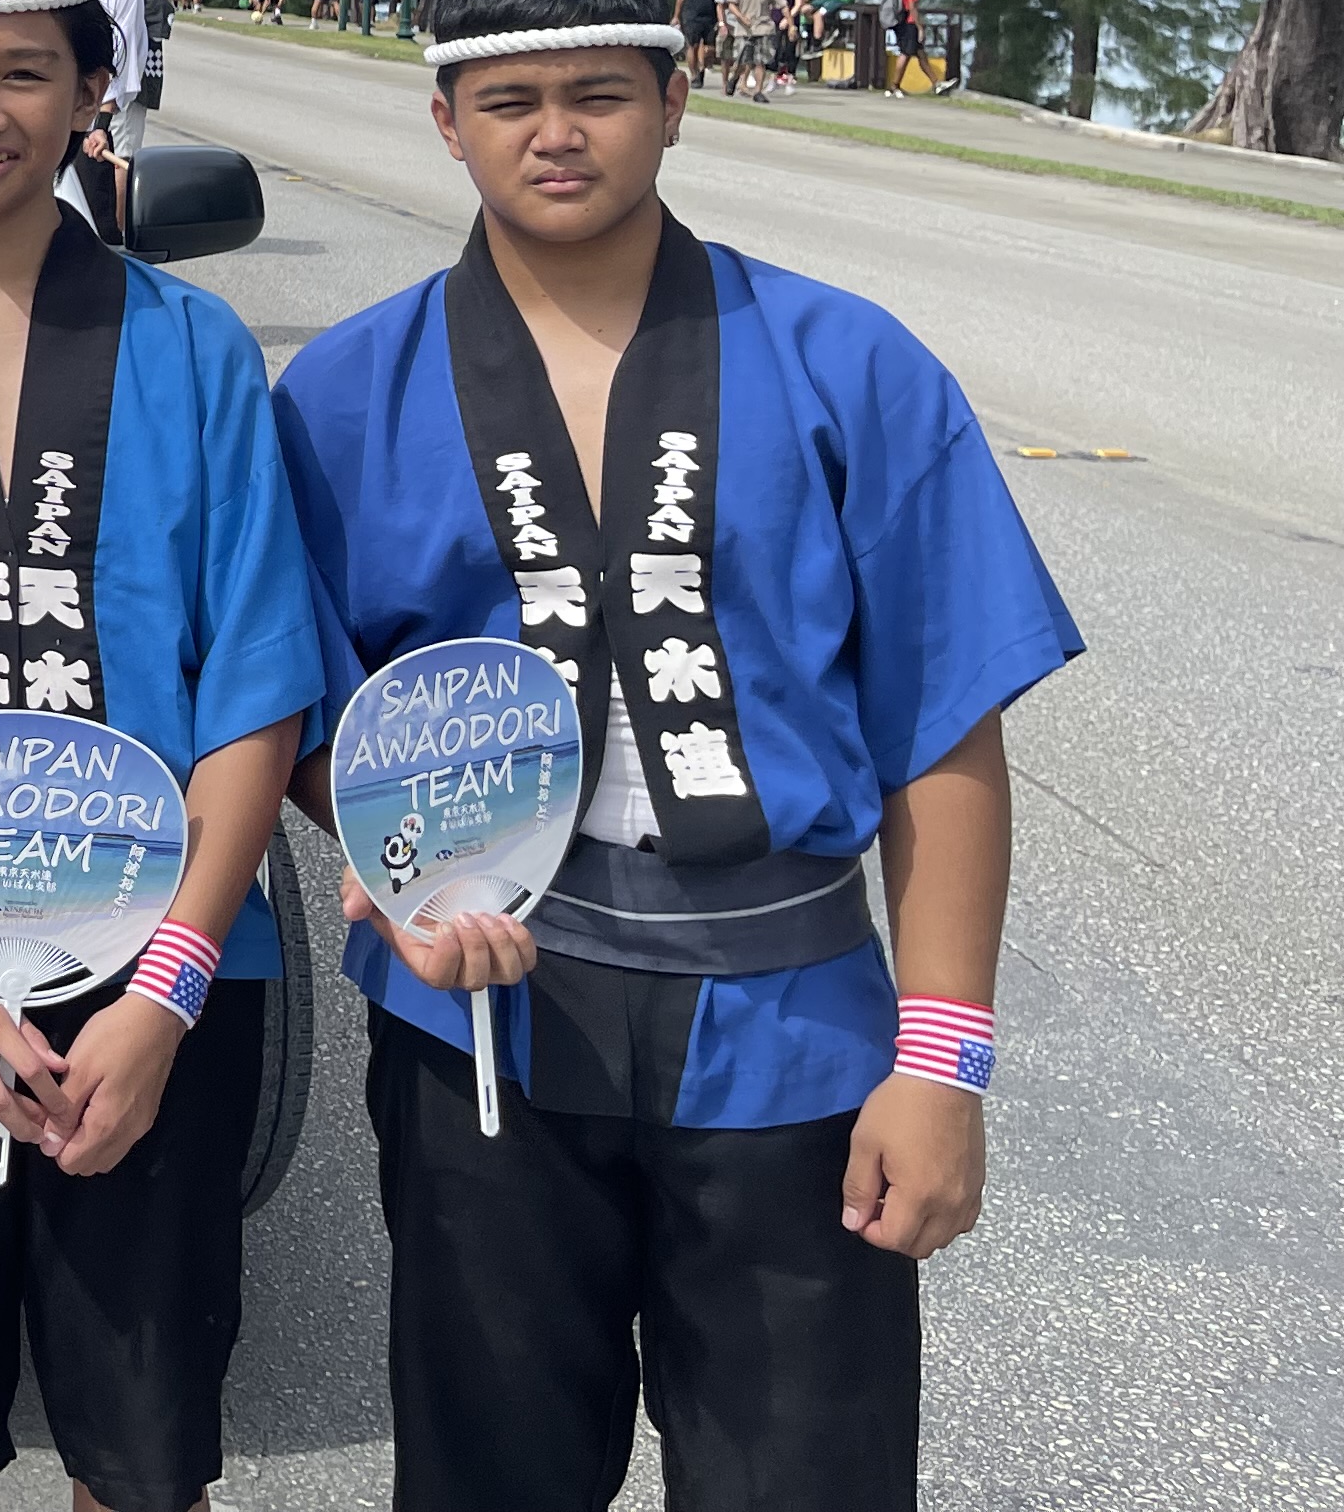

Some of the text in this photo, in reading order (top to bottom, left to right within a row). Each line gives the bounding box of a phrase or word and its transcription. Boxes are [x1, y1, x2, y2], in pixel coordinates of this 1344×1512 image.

[496, 452, 558, 560] SAIPAN
[19, 451, 93, 711] SAIPAN 天水
[630, 431, 747, 799] SAIPAN 天水連
[381, 655, 520, 720] SAIPAN
[347, 699, 561, 775] AWAODORI
[401, 752, 514, 810] TEAM
